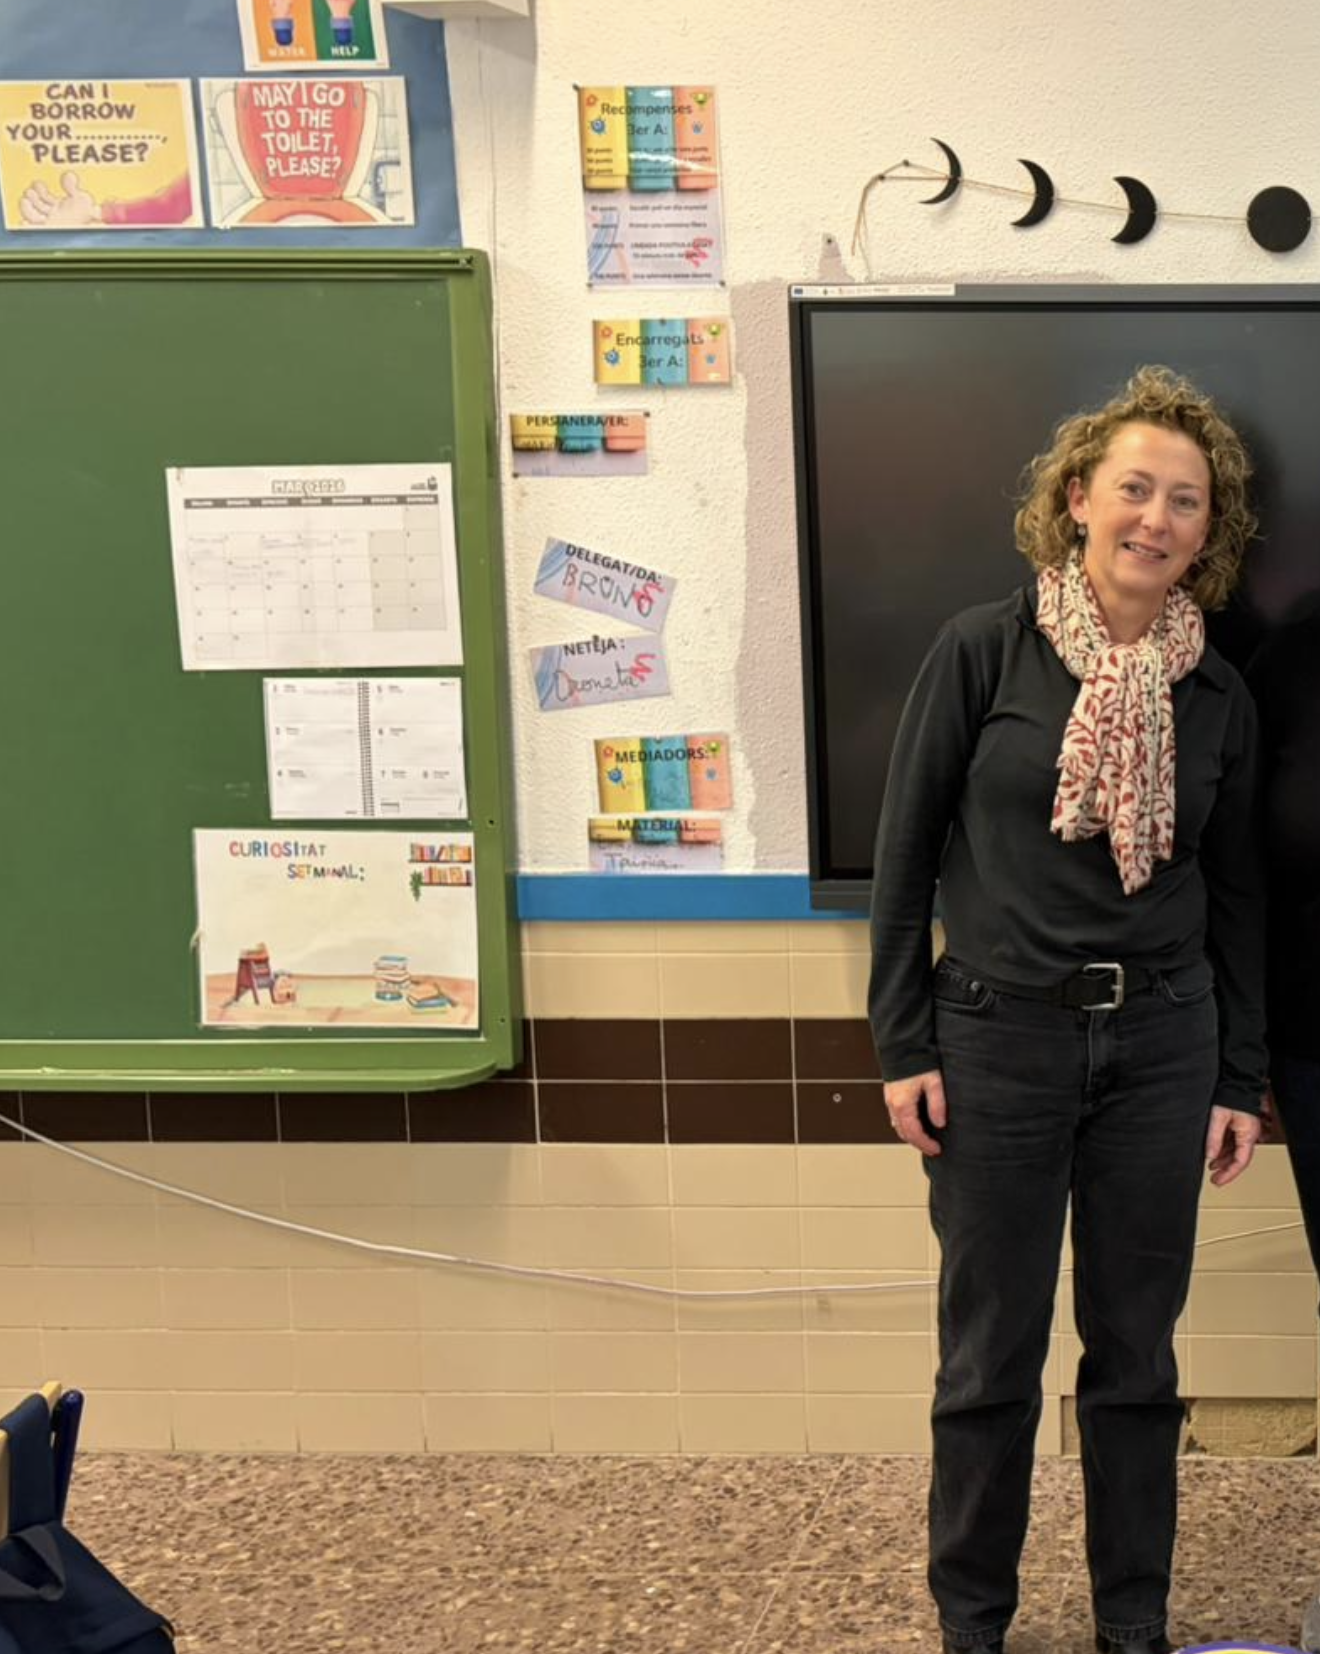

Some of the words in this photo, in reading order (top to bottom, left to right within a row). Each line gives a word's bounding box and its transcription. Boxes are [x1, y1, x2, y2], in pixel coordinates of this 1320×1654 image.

[331, 45, 360, 57] HELP
[46, 83, 95, 100] CAN
[102, 83, 110, 100] I
[252, 81, 297, 108] MAY
[301, 81, 308, 106] I
[313, 83, 345, 107] GO
[30, 102, 136, 121] BORROW
[601, 102, 693, 116] Recompenses
[261, 109, 291, 130] TO
[296, 107, 333, 129] THE
[627, 123, 649, 136] 3er
[653, 123, 668, 136] A:
[261, 130, 338, 156] TOILET,
[31, 143, 149, 164] PLEASE?
[266, 156, 342, 178] PLEASE?
[616, 333, 704, 348] Encarregats
[639, 355, 662, 368] 3er
[667, 354, 684, 367] A:
[615, 747, 709, 763] MEDIADORS:
[617, 819, 696, 832] MATERIAL:
[229, 841, 327, 858] CURIOSITAT
[287, 864, 365, 882] SETMANAL:
